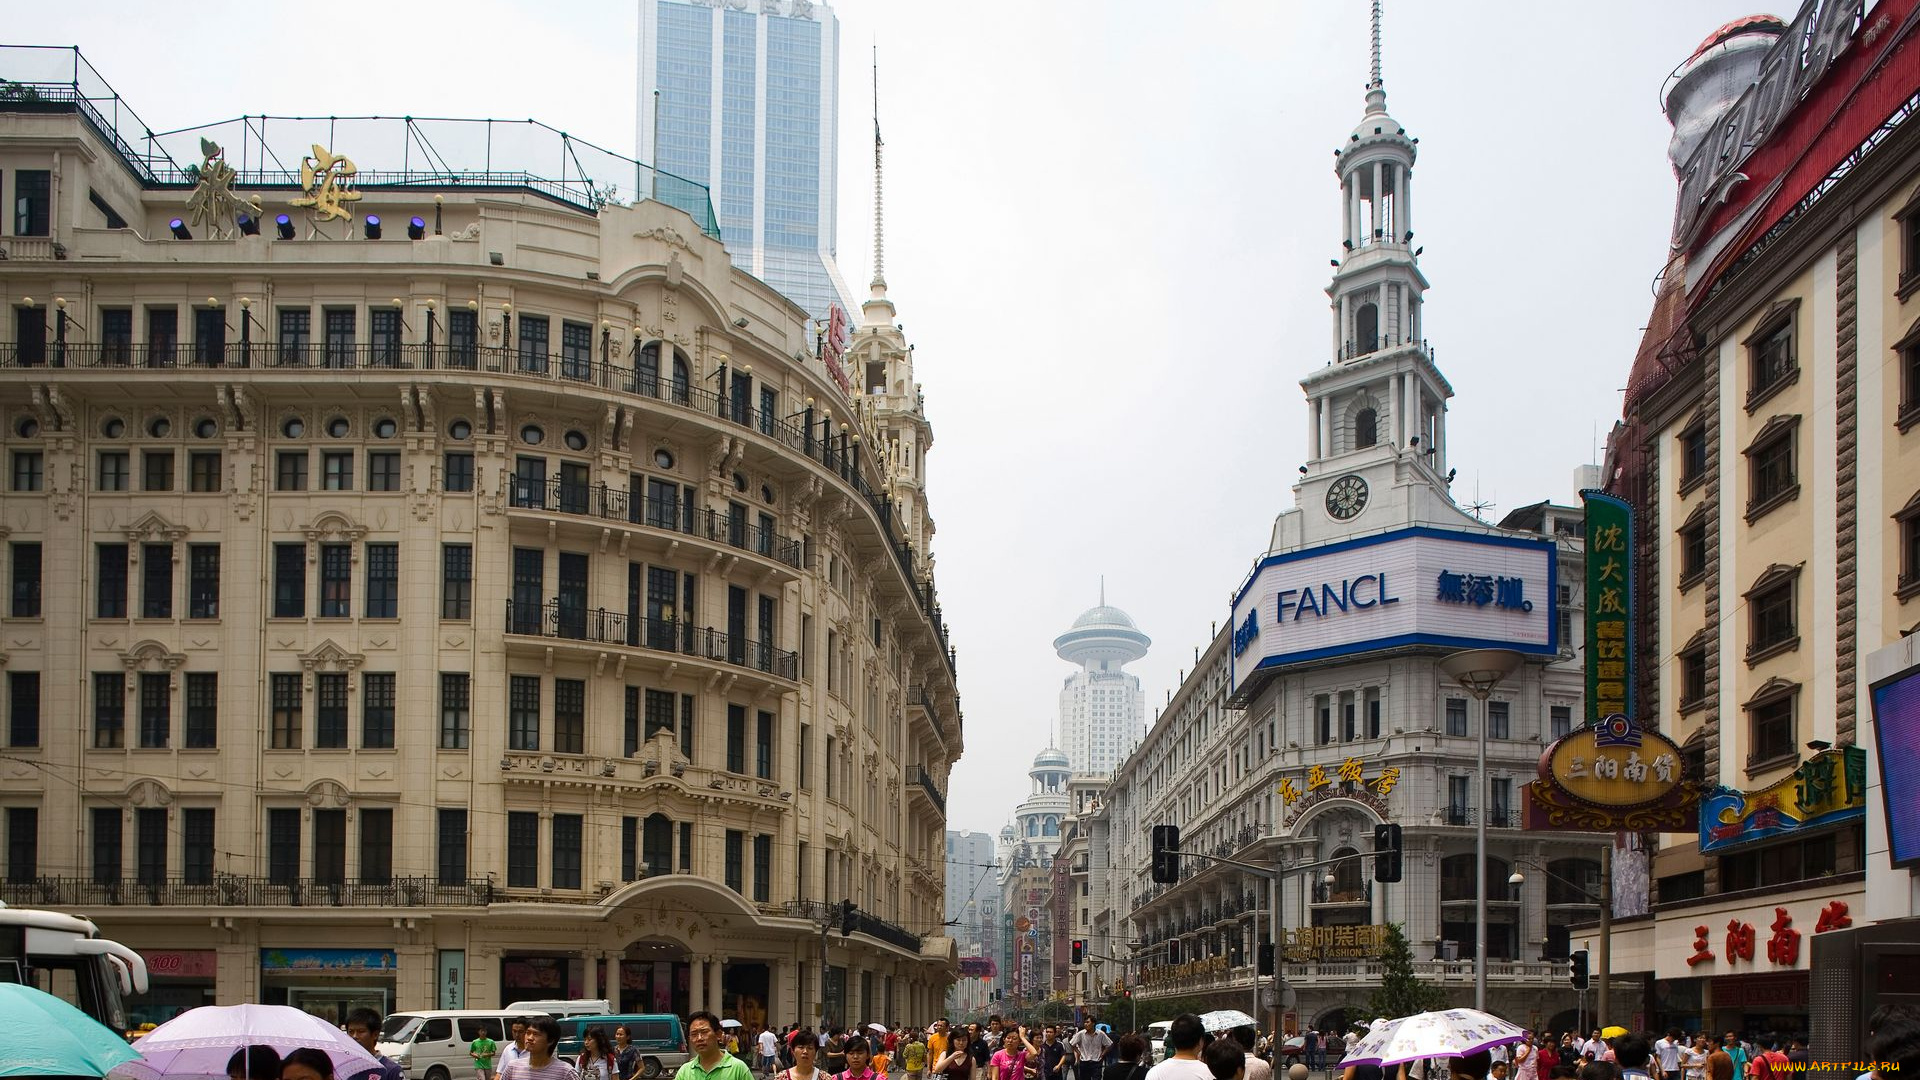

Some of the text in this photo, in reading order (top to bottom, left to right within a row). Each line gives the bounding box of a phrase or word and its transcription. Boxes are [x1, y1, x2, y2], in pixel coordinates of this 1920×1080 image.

[1594, 525, 1627, 614] 沈大成
[1277, 572, 1399, 623] FANCL
[1277, 757, 1400, 806] 东亚饭店
[1565, 752, 1675, 782] 三阳南货
[1317, 786, 1348, 802] ASIA
[150, 955, 182, 970] 100
[1323, 948, 1361, 957] FASHION
[448, 968, 459, 1010] 周生
